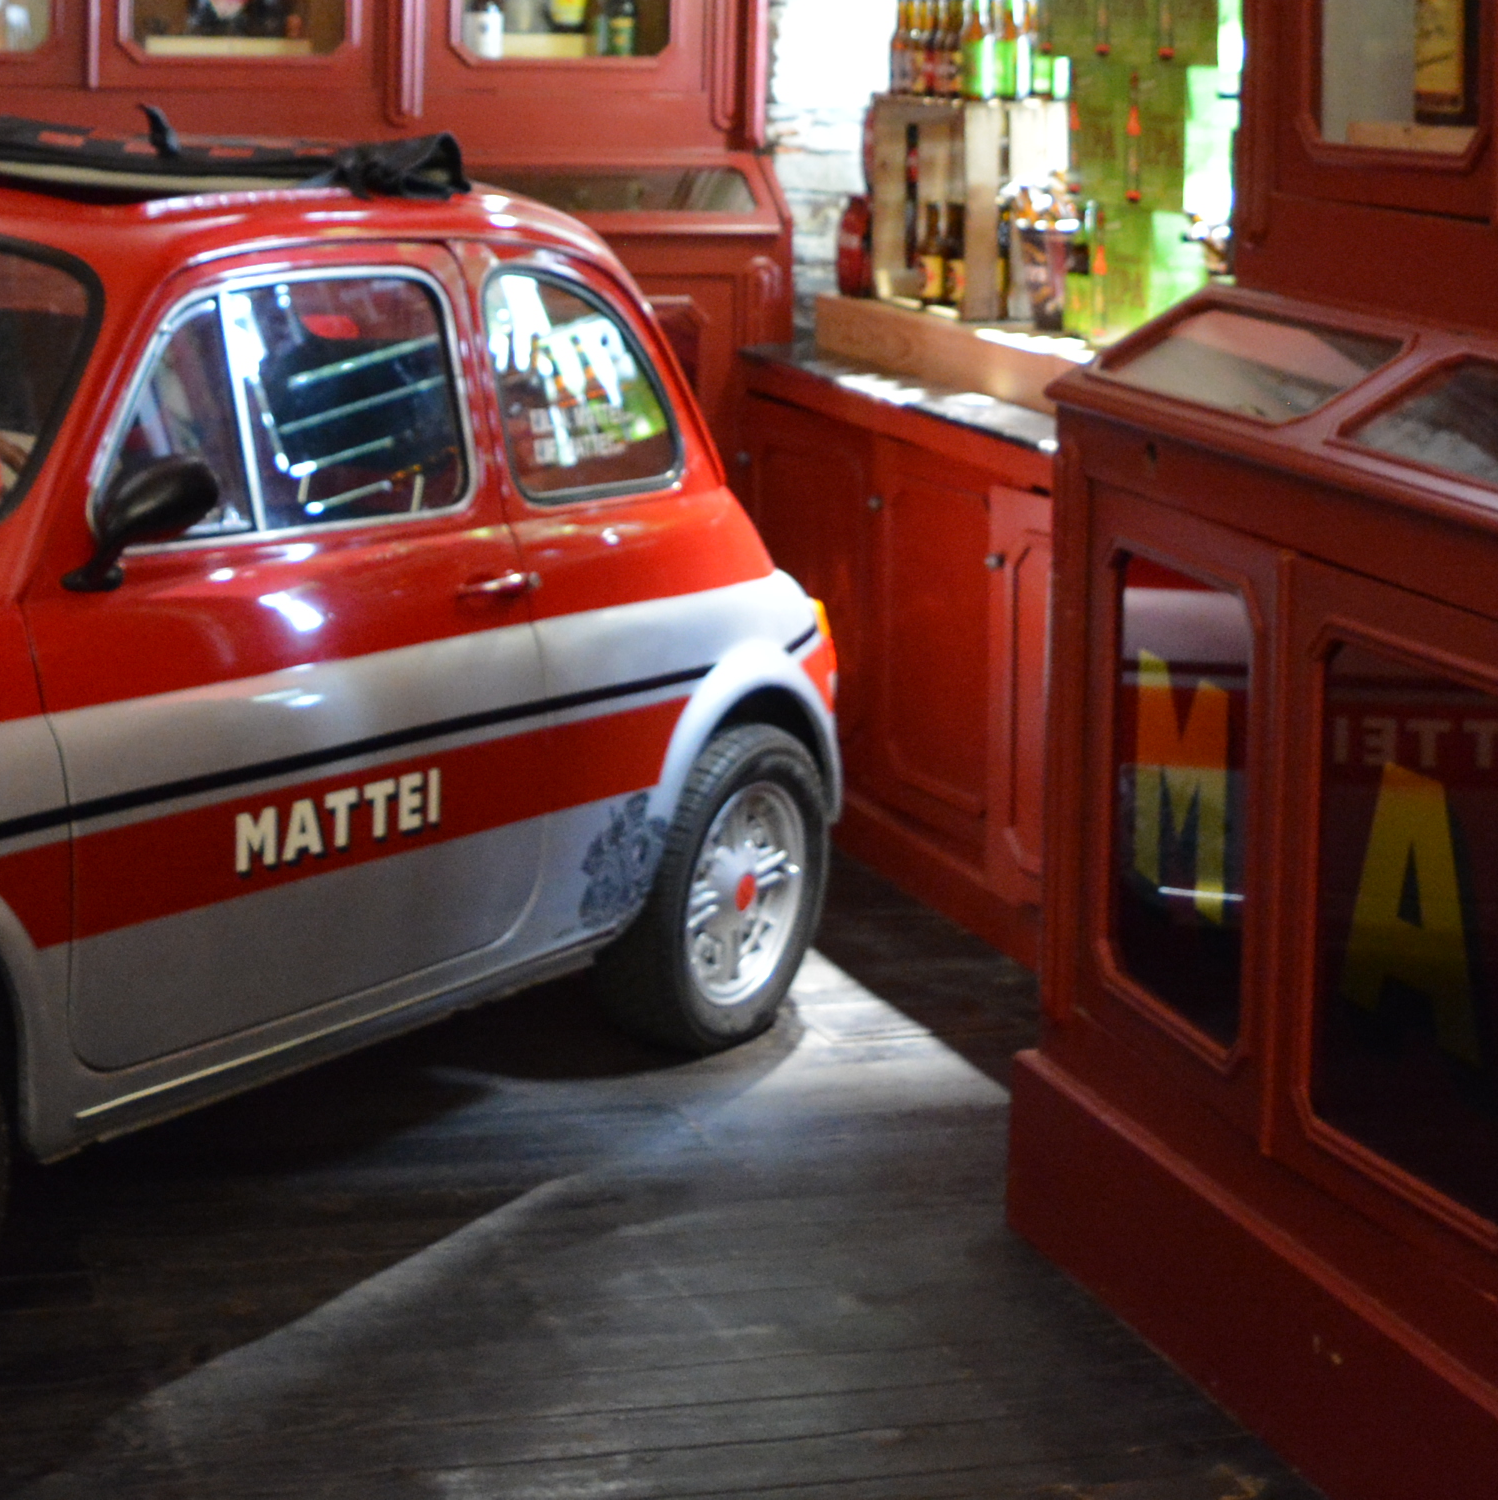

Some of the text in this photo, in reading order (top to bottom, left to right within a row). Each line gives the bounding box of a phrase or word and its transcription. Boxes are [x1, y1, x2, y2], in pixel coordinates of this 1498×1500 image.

[235, 765, 443, 878] MATTEI
[1133, 648, 1229, 926] M
[1338, 761, 1483, 1069] A
